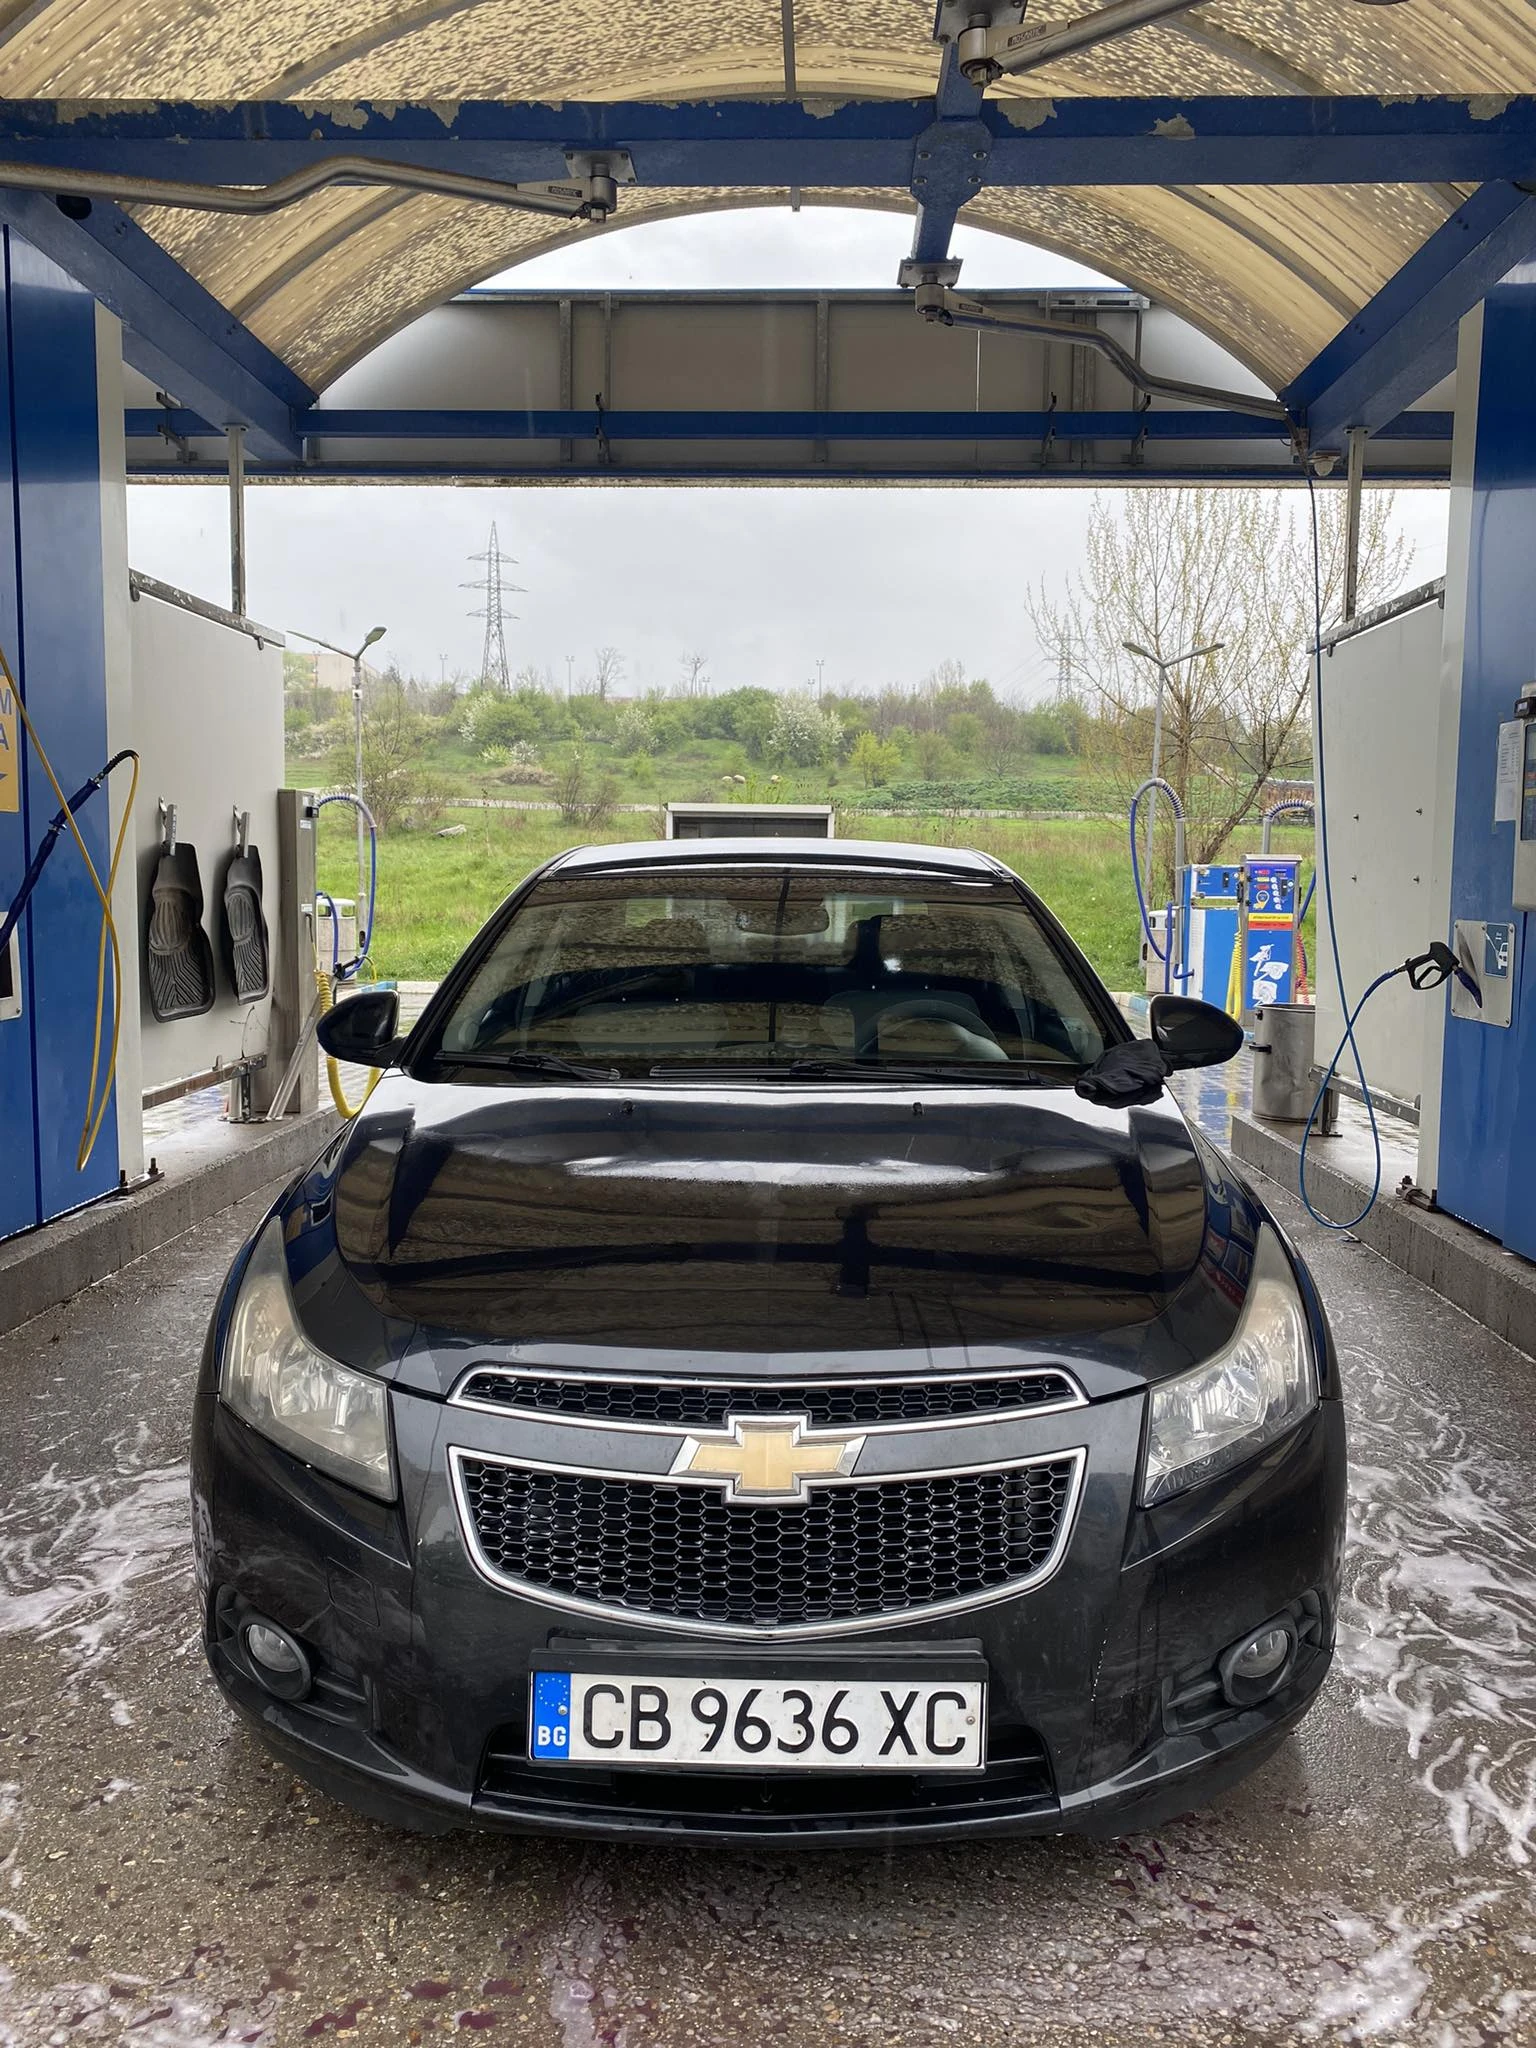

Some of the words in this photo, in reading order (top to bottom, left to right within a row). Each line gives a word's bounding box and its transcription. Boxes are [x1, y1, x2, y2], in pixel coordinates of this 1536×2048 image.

[537, 1725, 567, 1747] BG
[582, 1683, 671, 1750] CB
[690, 1687, 860, 1755] 9636
[878, 1690, 967, 1756] XC
